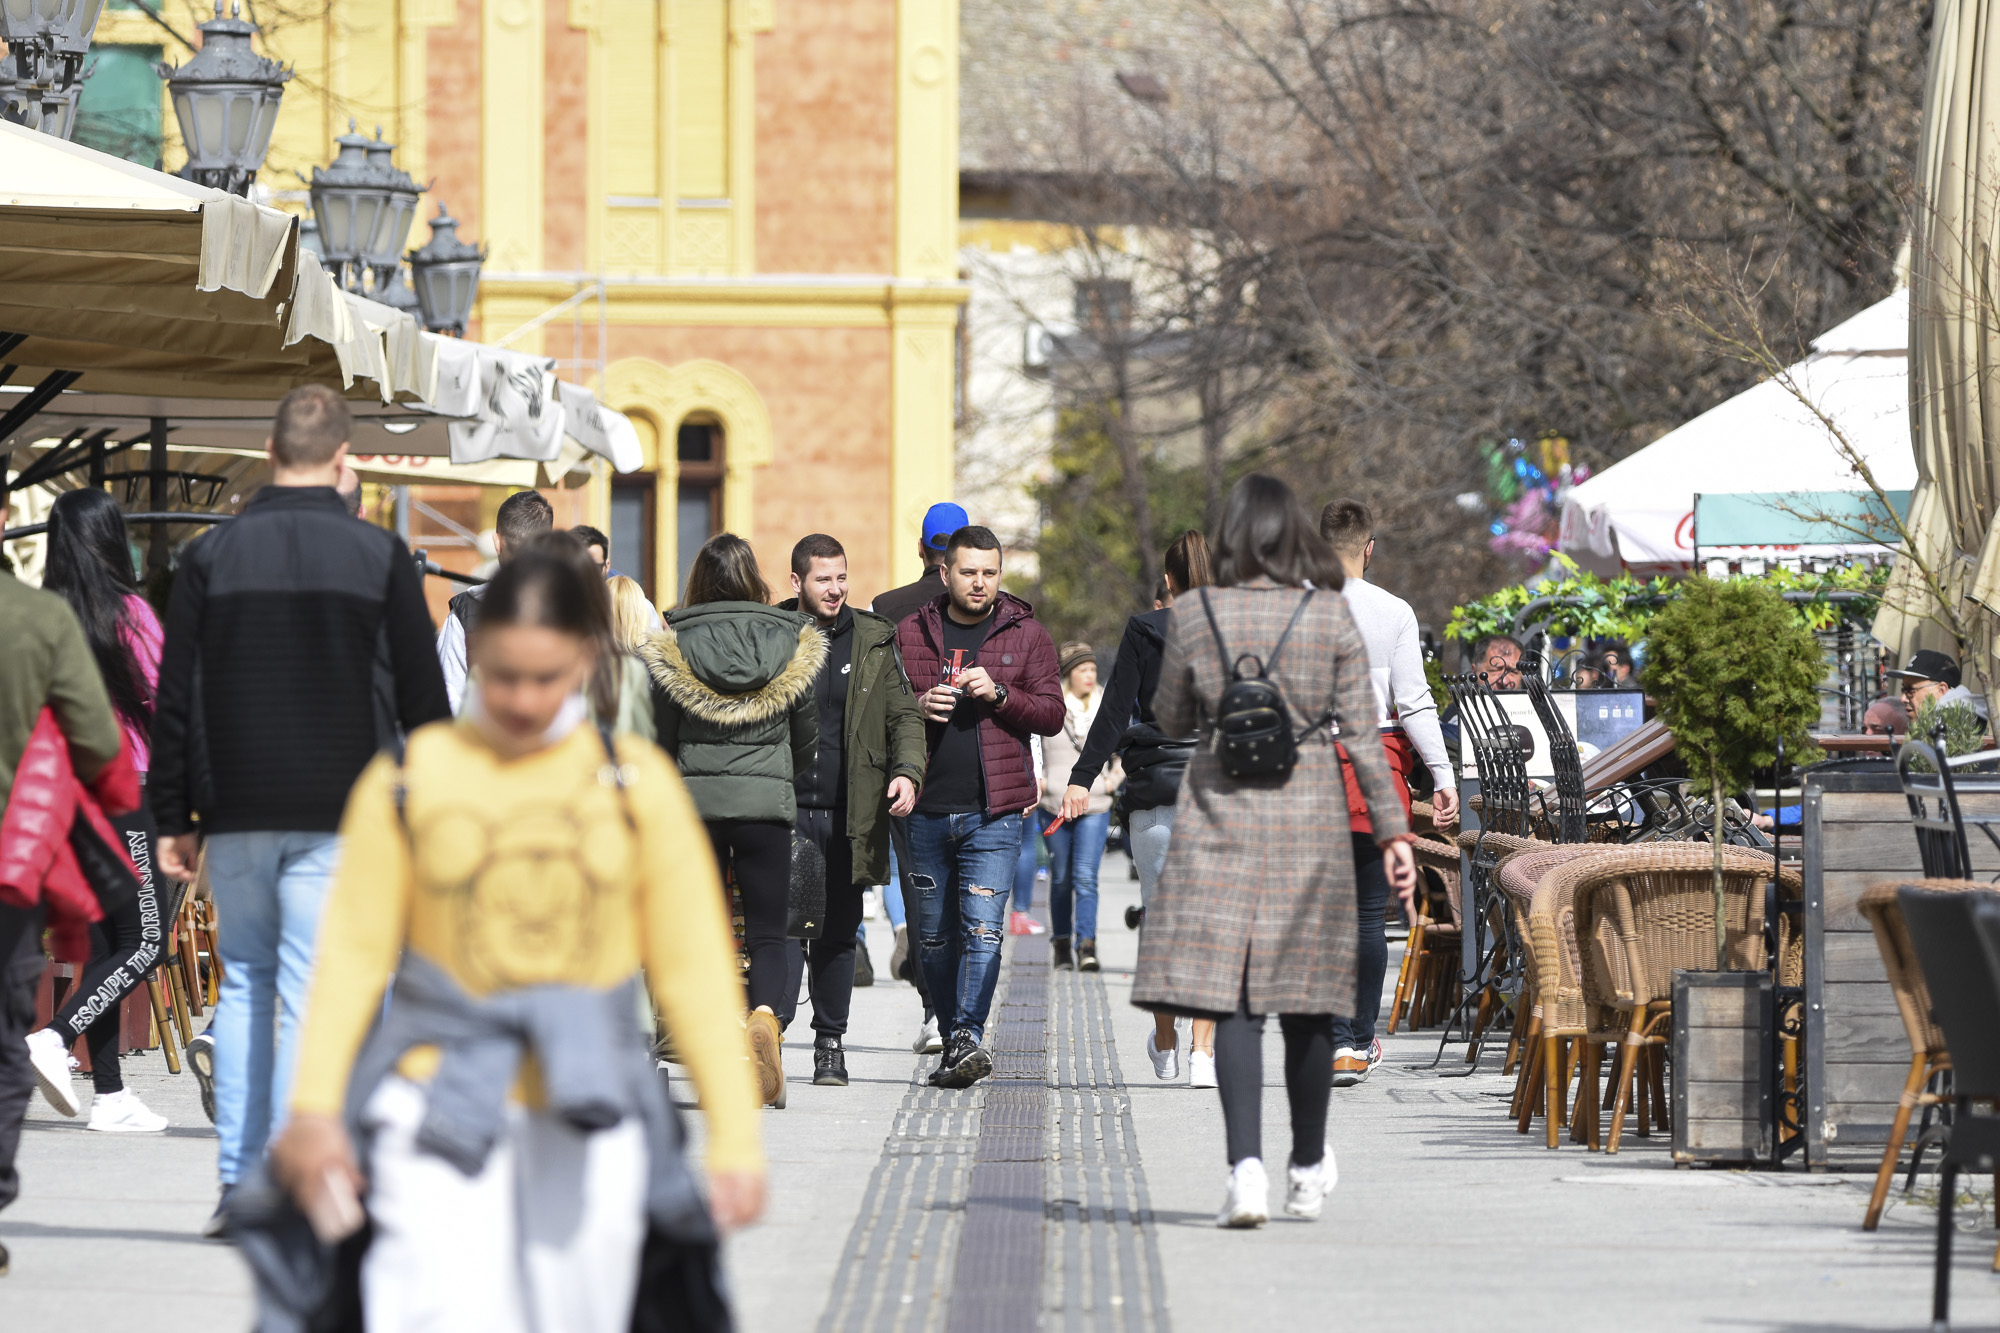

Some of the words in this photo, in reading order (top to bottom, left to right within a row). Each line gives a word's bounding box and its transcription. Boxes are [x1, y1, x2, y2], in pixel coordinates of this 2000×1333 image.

[126, 830, 162, 942] ORDINARY
[126, 941, 160, 974] THE
[69, 967, 135, 1035] ESCAPE
